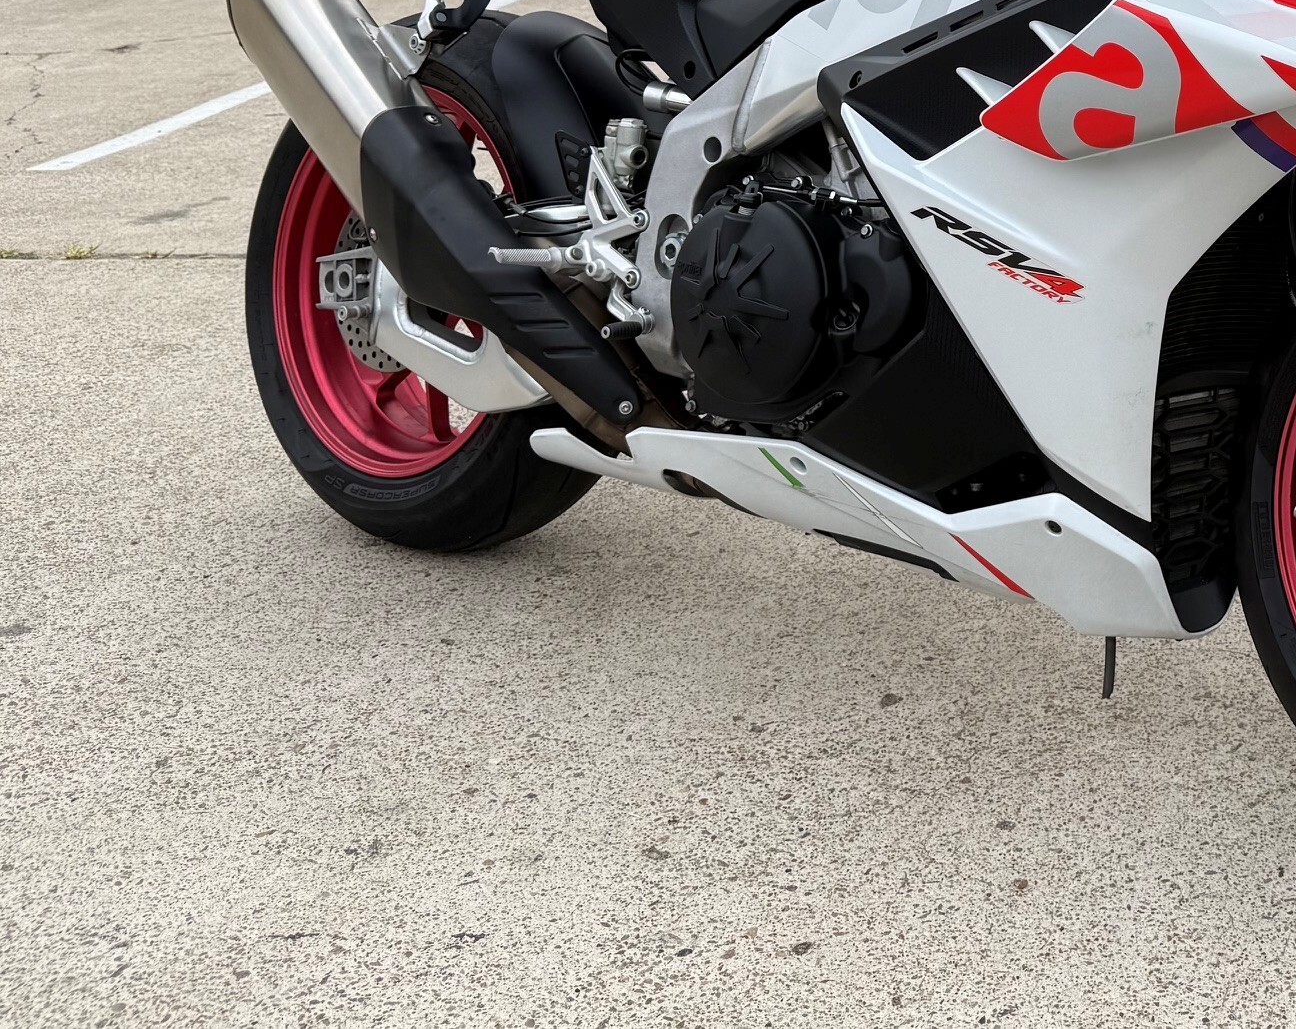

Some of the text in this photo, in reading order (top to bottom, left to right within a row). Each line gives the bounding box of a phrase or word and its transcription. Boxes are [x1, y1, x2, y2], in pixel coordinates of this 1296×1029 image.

[910, 206, 1085, 299] RSV4
[987, 260, 1072, 304] FACTORY
[324, 474, 438, 501] SUPERCORSA SP
